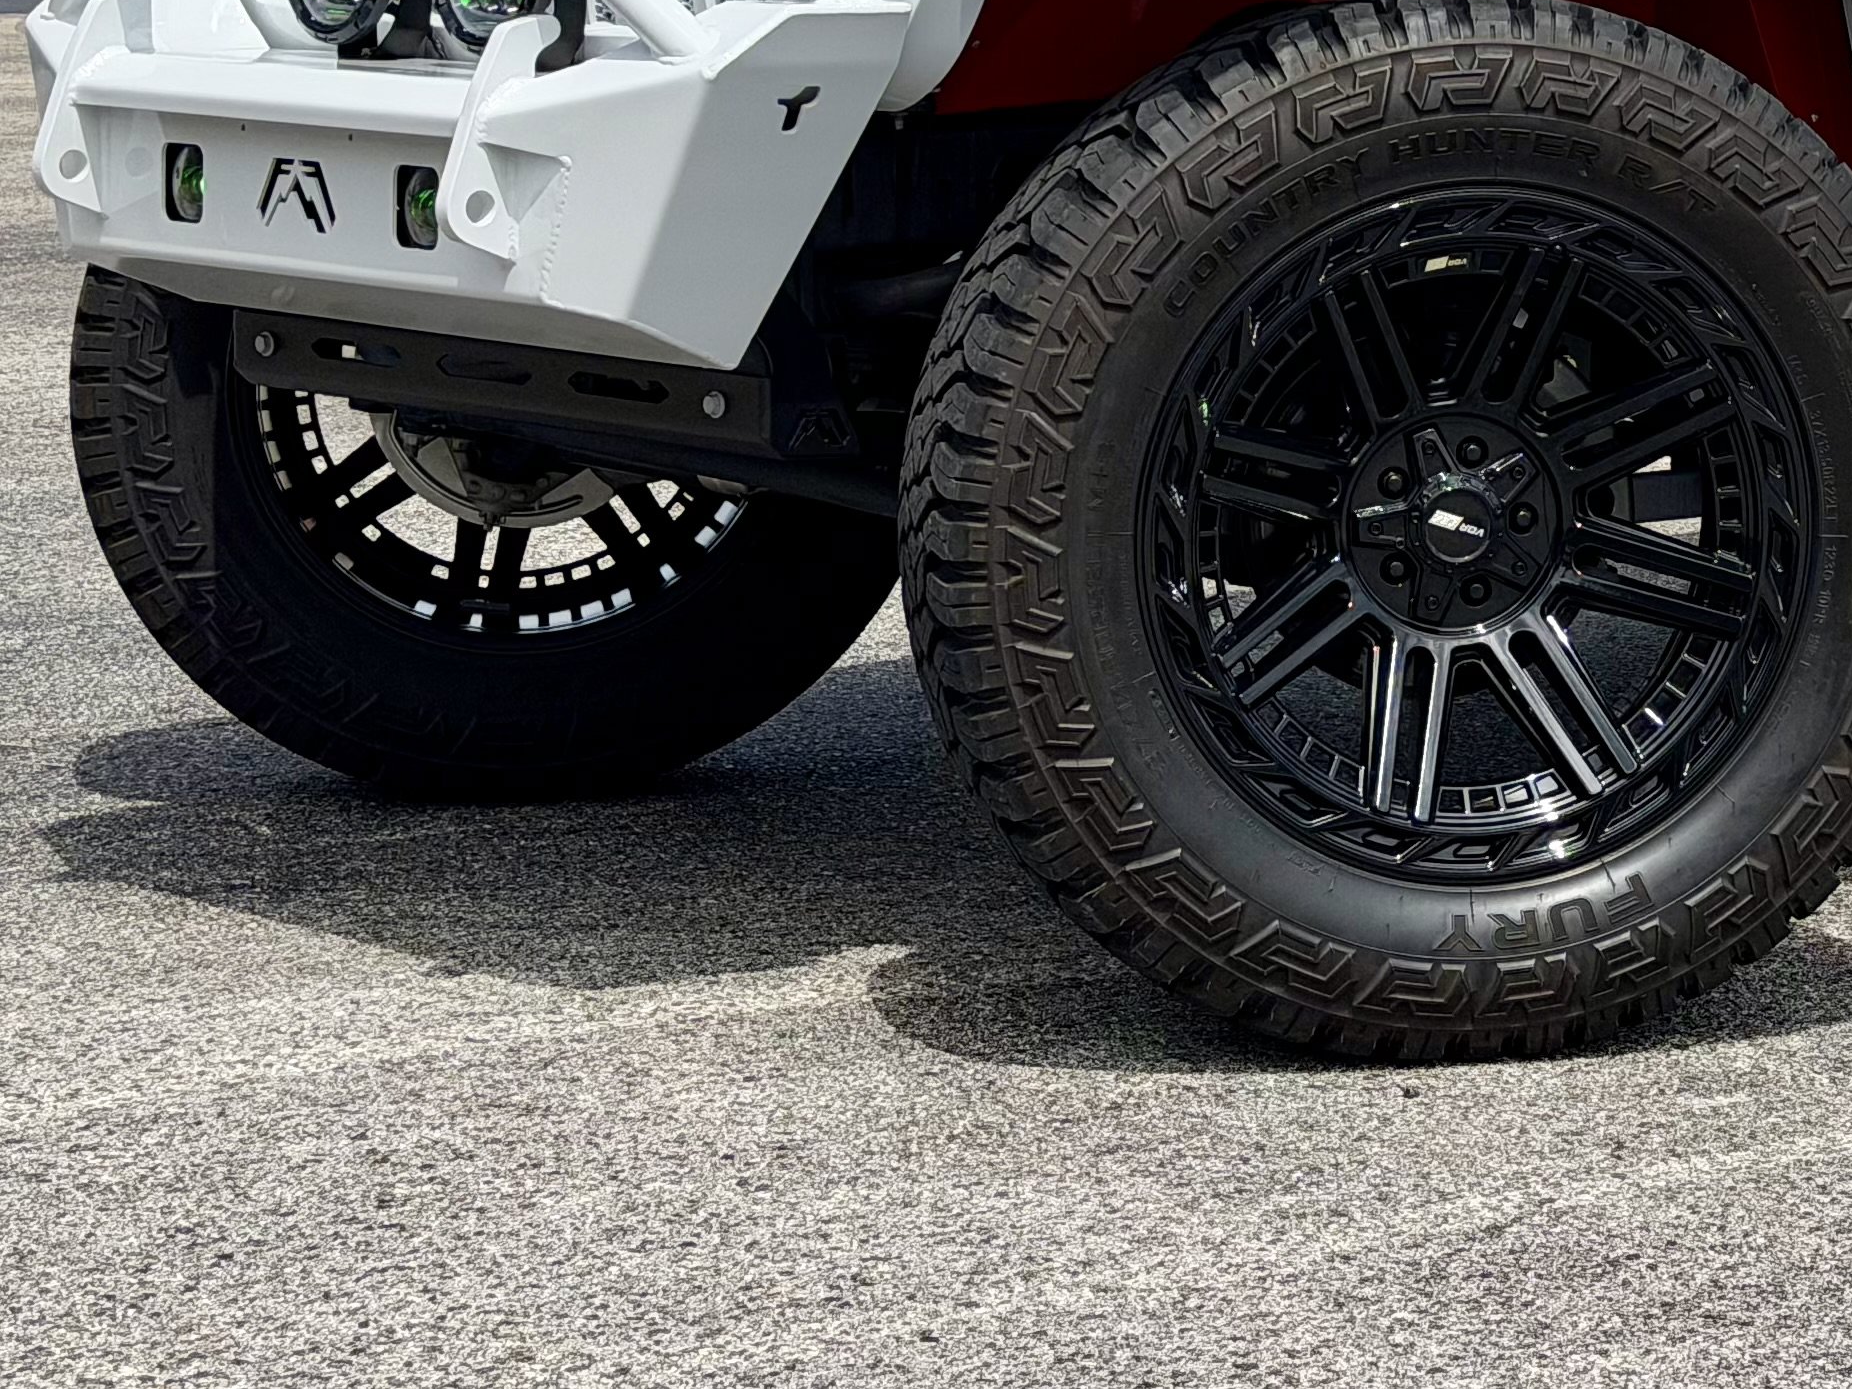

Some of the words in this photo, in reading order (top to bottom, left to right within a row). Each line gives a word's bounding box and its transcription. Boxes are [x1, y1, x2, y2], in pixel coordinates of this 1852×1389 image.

[1163, 147, 1370, 317] COUNTRY
[1387, 127, 1602, 171] HUNTER
[1617, 153, 1719, 213] R/T
[1432, 871, 1656, 953] FURY
